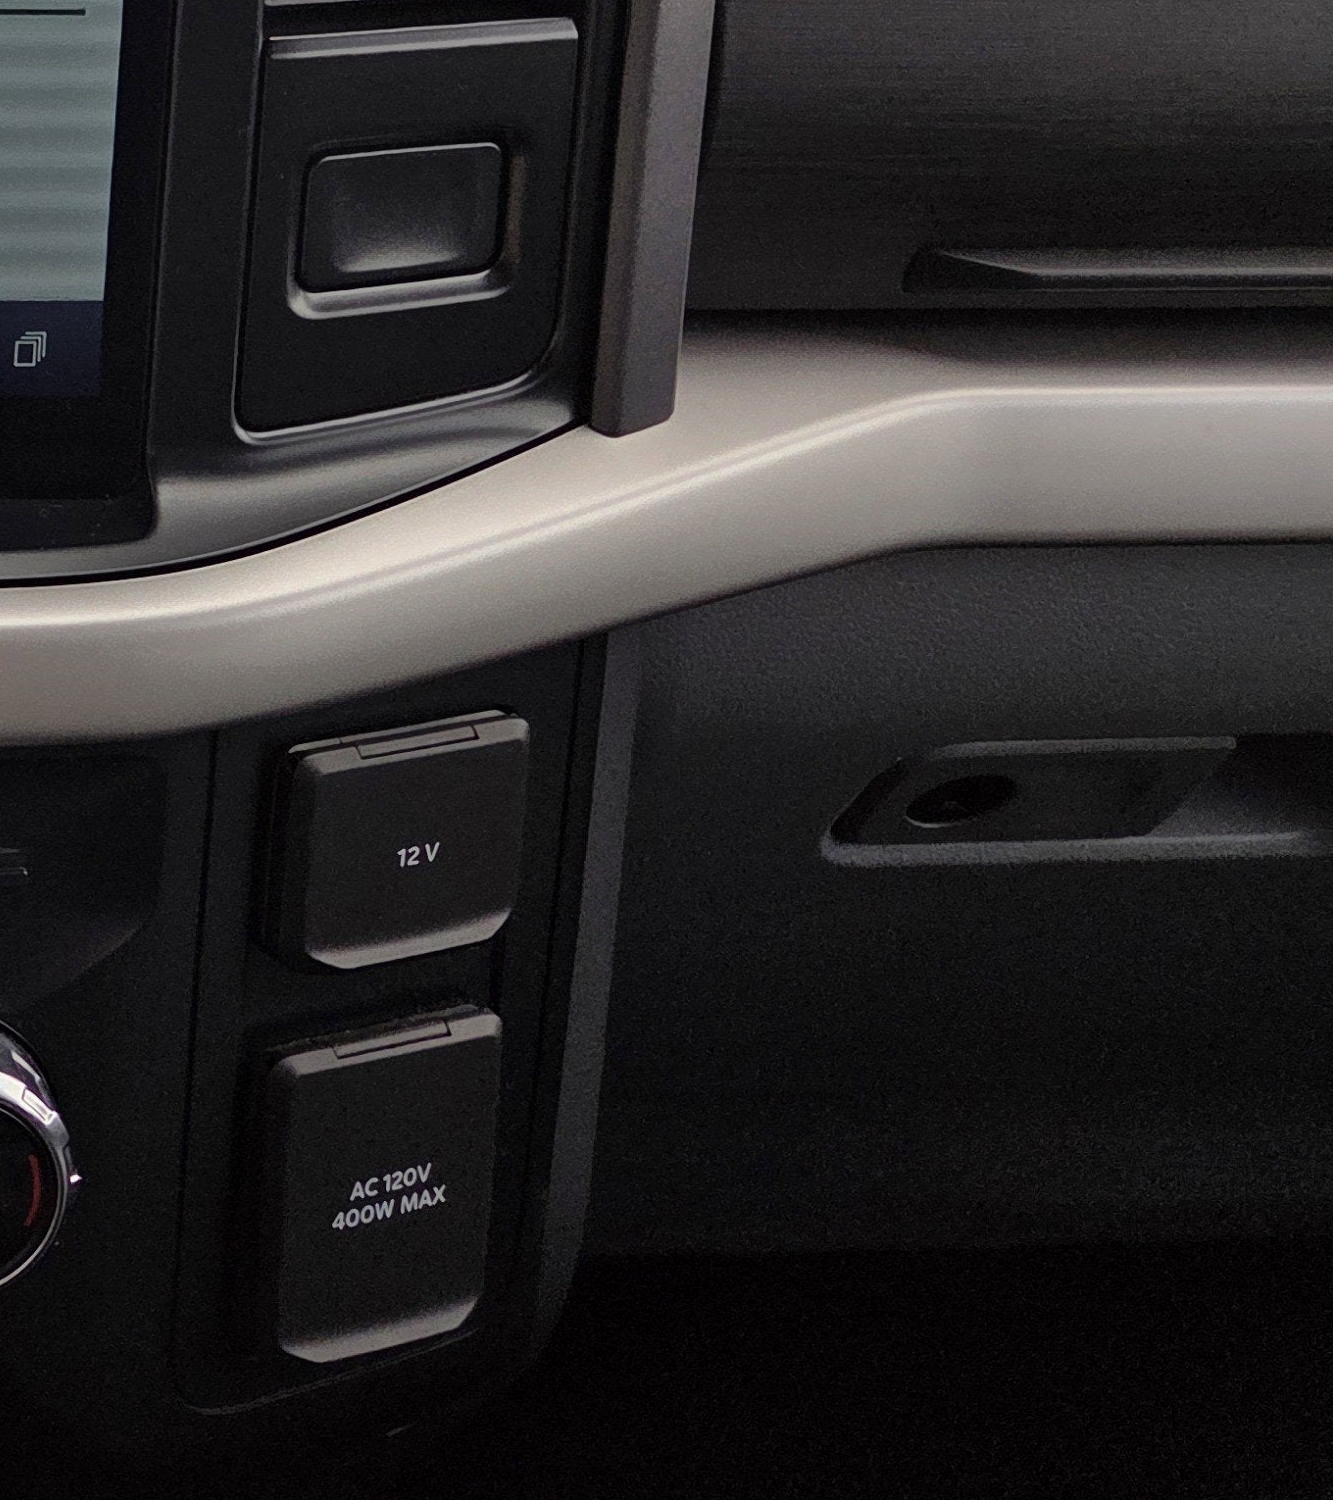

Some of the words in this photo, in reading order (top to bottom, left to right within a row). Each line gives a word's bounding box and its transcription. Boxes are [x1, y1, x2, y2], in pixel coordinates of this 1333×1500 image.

[349, 1176, 379, 1201] AC
[382, 1162, 432, 1192] 120V
[331, 1198, 395, 1230] 400W
[400, 1184, 446, 1214] MAX
